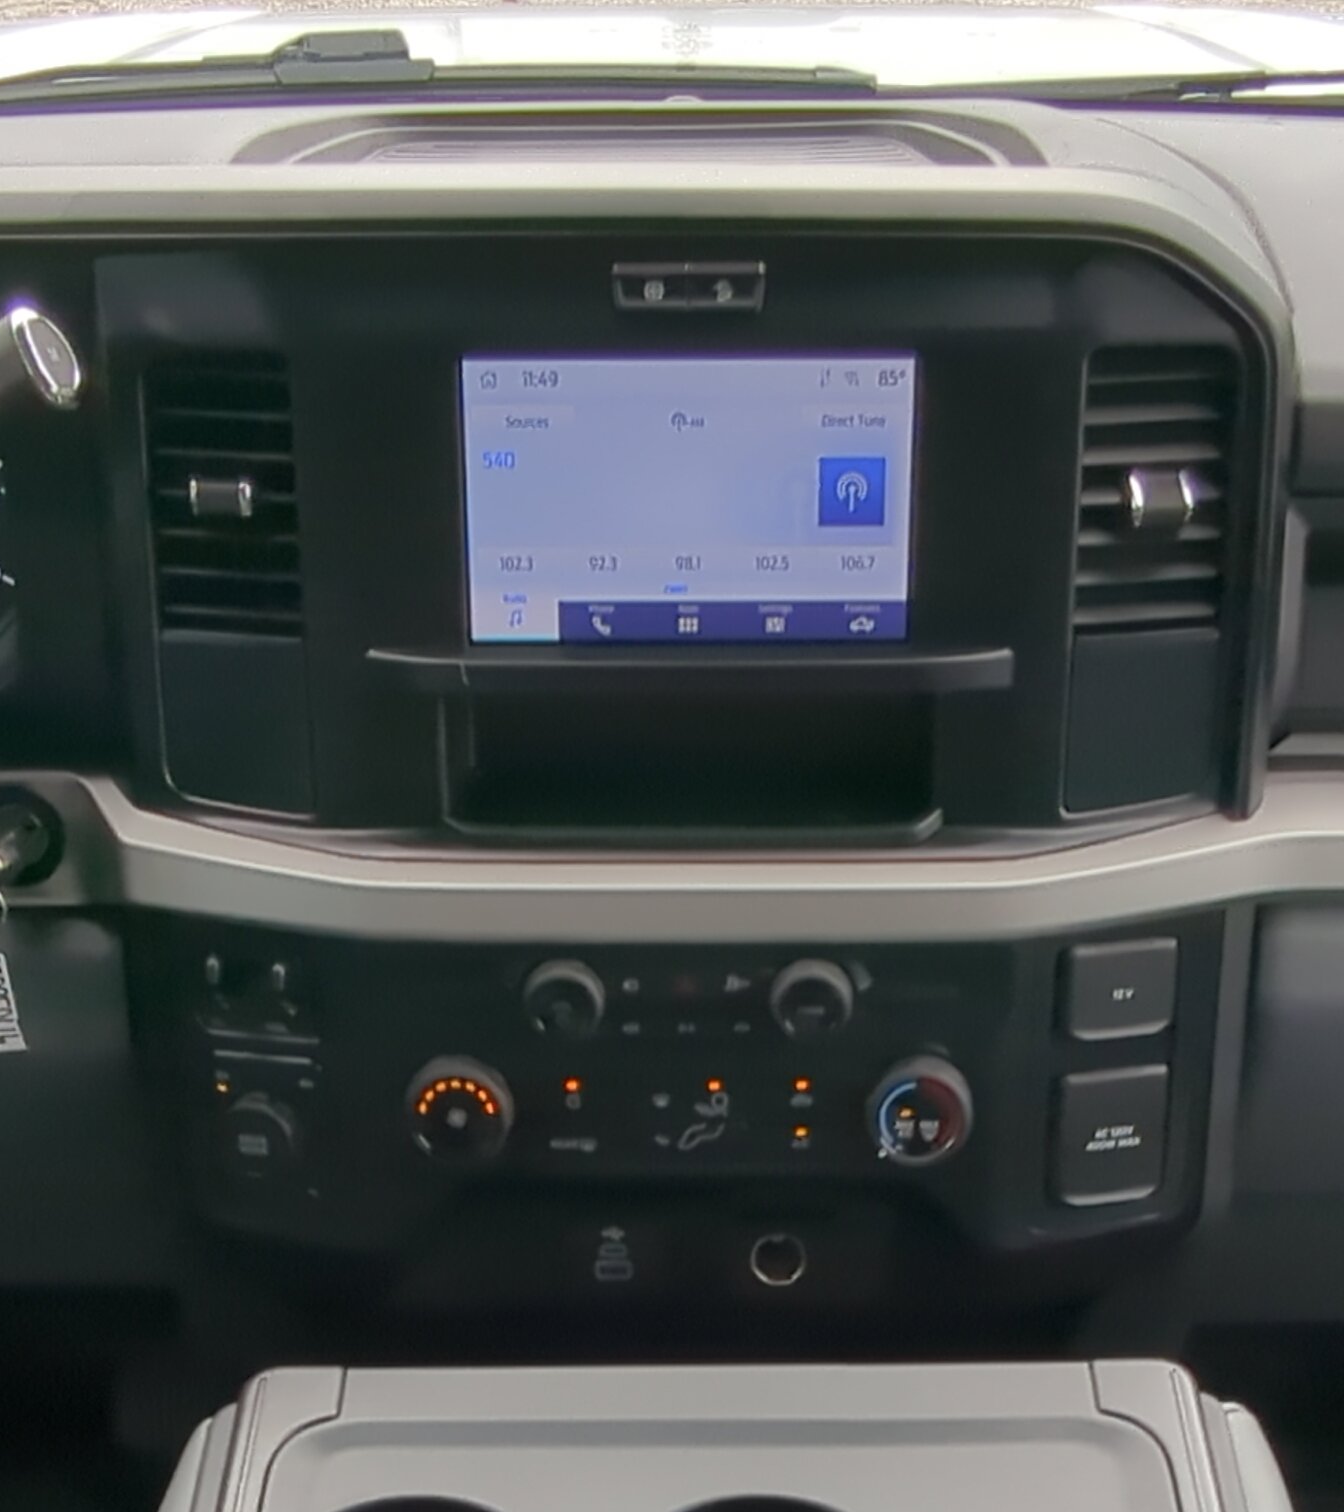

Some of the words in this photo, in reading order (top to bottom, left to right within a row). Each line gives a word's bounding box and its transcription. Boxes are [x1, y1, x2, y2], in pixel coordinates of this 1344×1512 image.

[482, 451, 516, 469] 540
[499, 556, 534, 572] 102.3
[755, 556, 789, 572] 102.5
